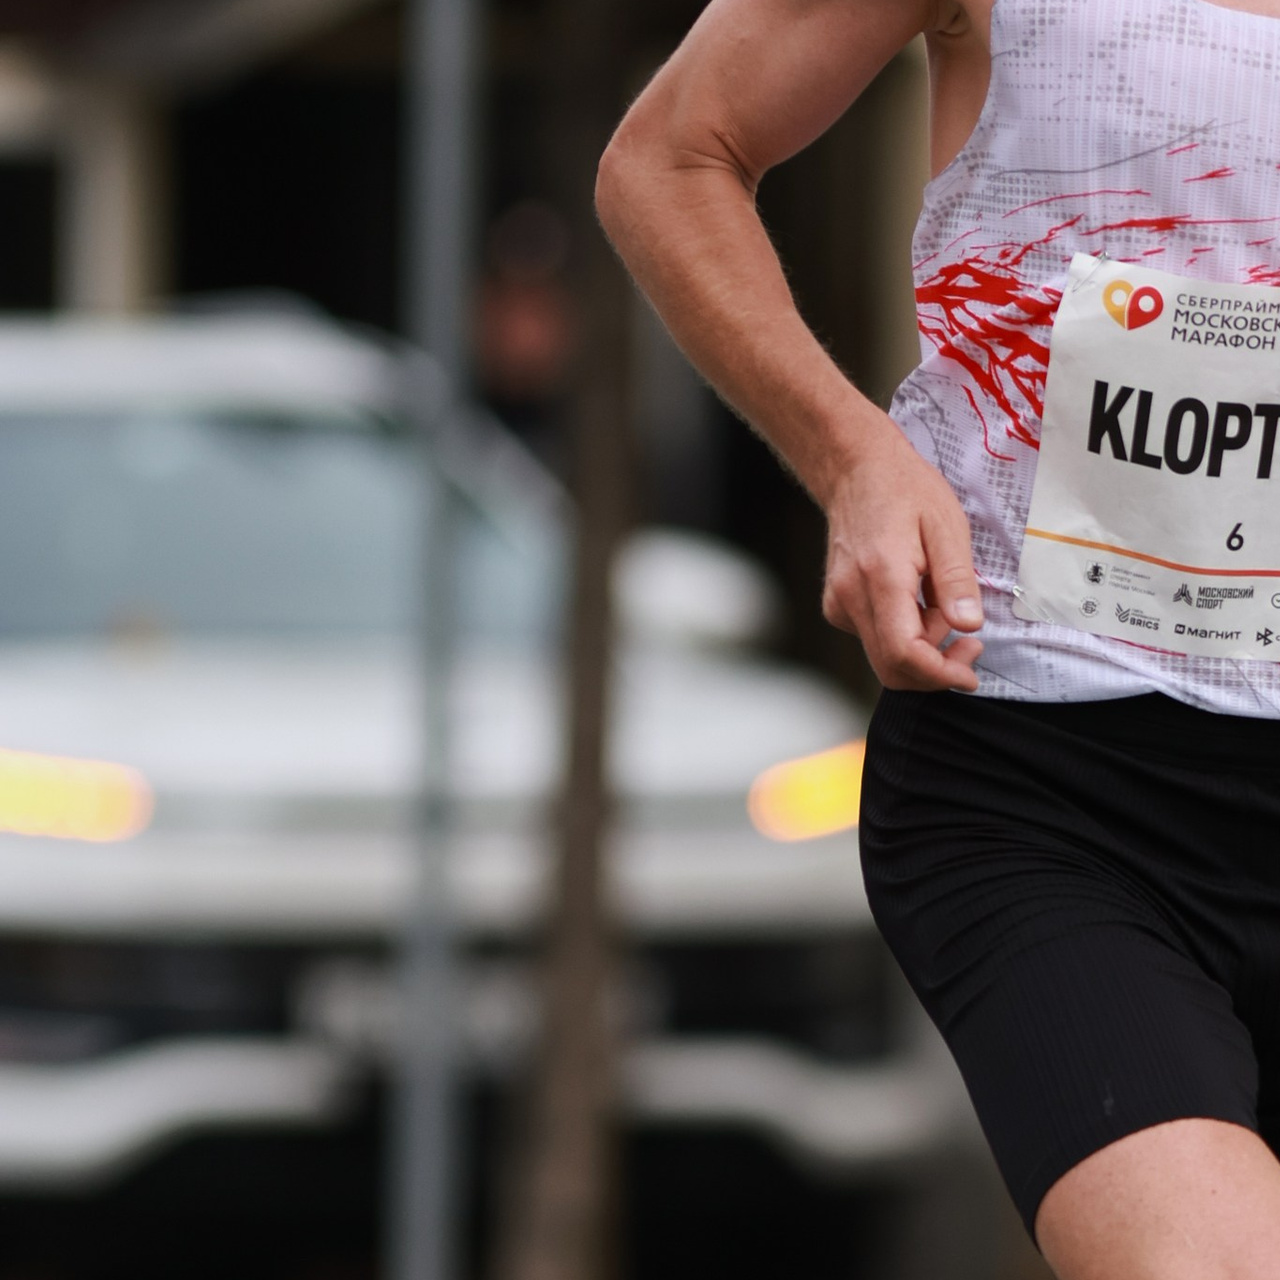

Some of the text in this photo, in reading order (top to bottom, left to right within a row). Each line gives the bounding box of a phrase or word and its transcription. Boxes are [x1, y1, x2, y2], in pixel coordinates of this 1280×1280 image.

[1177, 293, 1280, 314] СБЕРПРАЙМ
[1170, 326, 1276, 351] МАРАФОН
[1225, 523, 1245, 552] 6
[1197, 585, 1255, 599] МОСКОВСКИЙ
[1196, 597, 1224, 610] СПОРТ
[1129, 616, 1160, 631] BRICS
[1187, 626, 1242, 640] магнит
